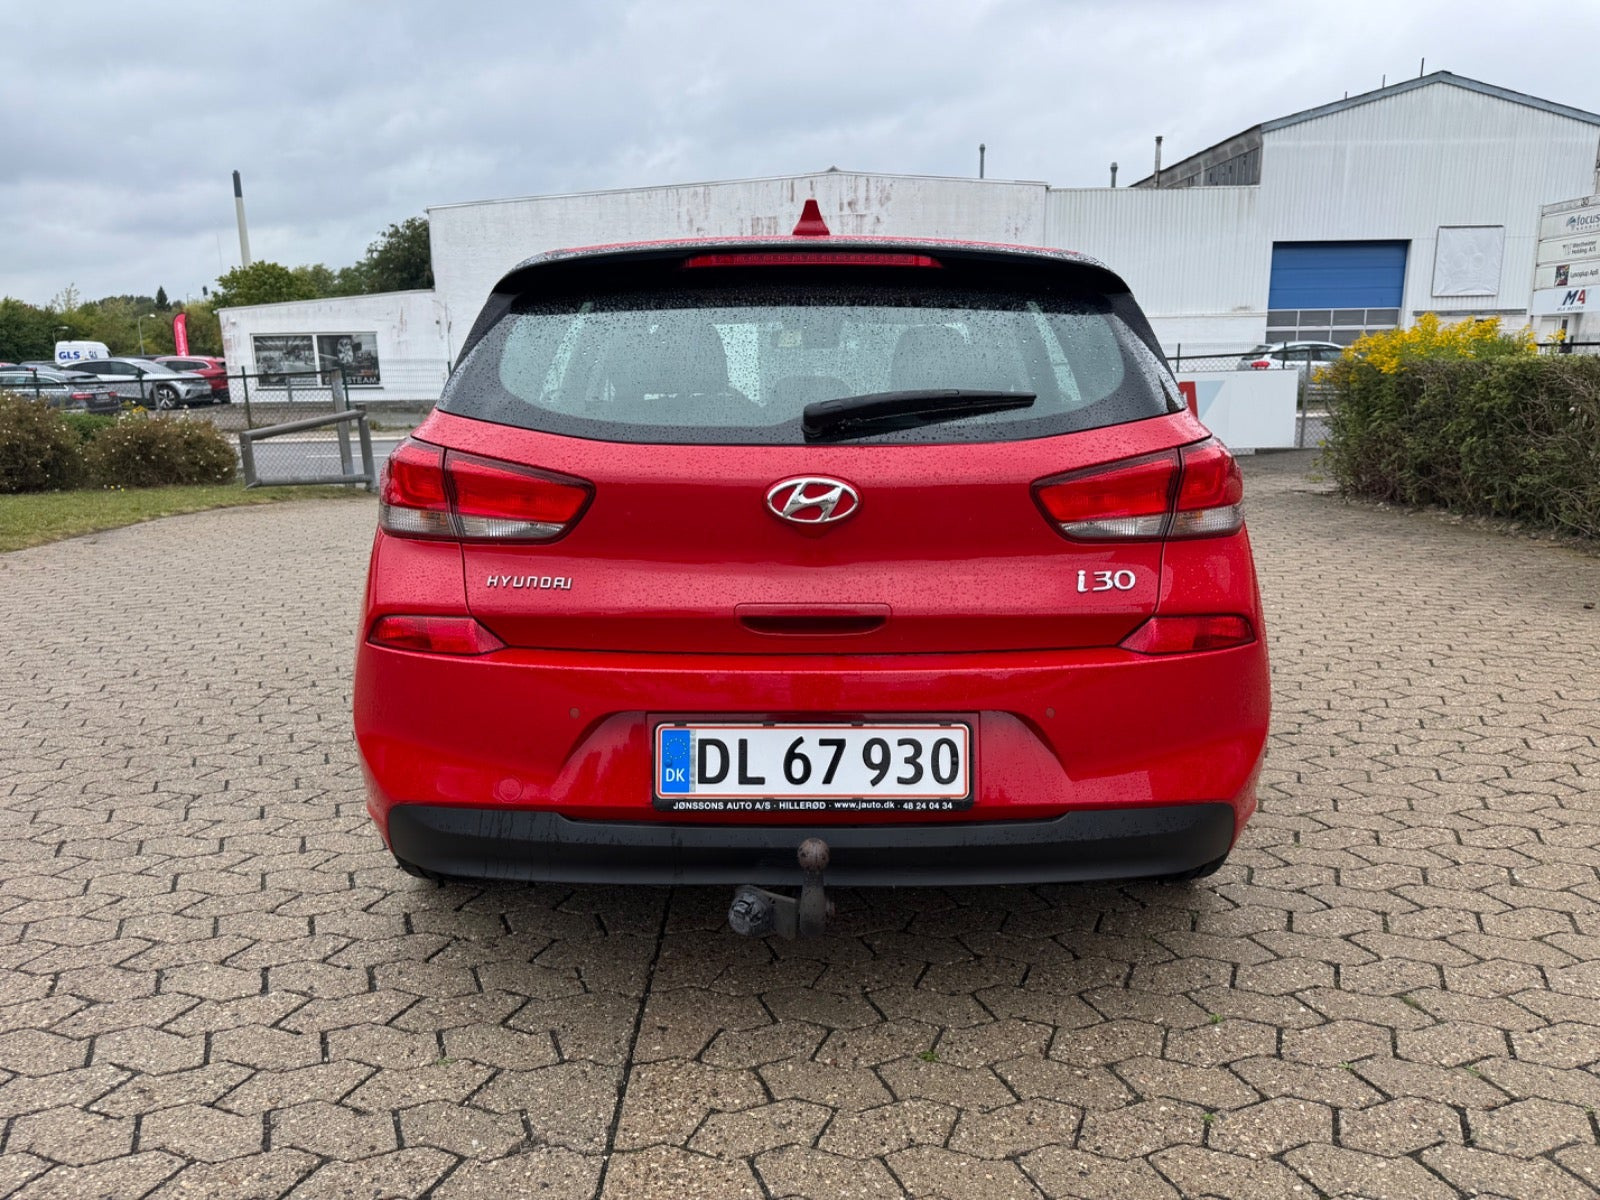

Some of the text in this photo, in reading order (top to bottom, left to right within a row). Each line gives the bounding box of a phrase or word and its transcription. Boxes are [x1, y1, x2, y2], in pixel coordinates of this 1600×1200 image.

[58, 350, 81, 360] GLS
[345, 376, 377, 384] STEAM
[486, 575, 572, 590] HYUNDAI
[1077, 569, 1136, 593] i30
[697, 736, 960, 788] DL 67 930
[665, 767, 686, 783] DK
[673, 800, 953, 810] JØNSSONS AUTO A/S HILLERØD www.jauto.dk 48 24 04 34
